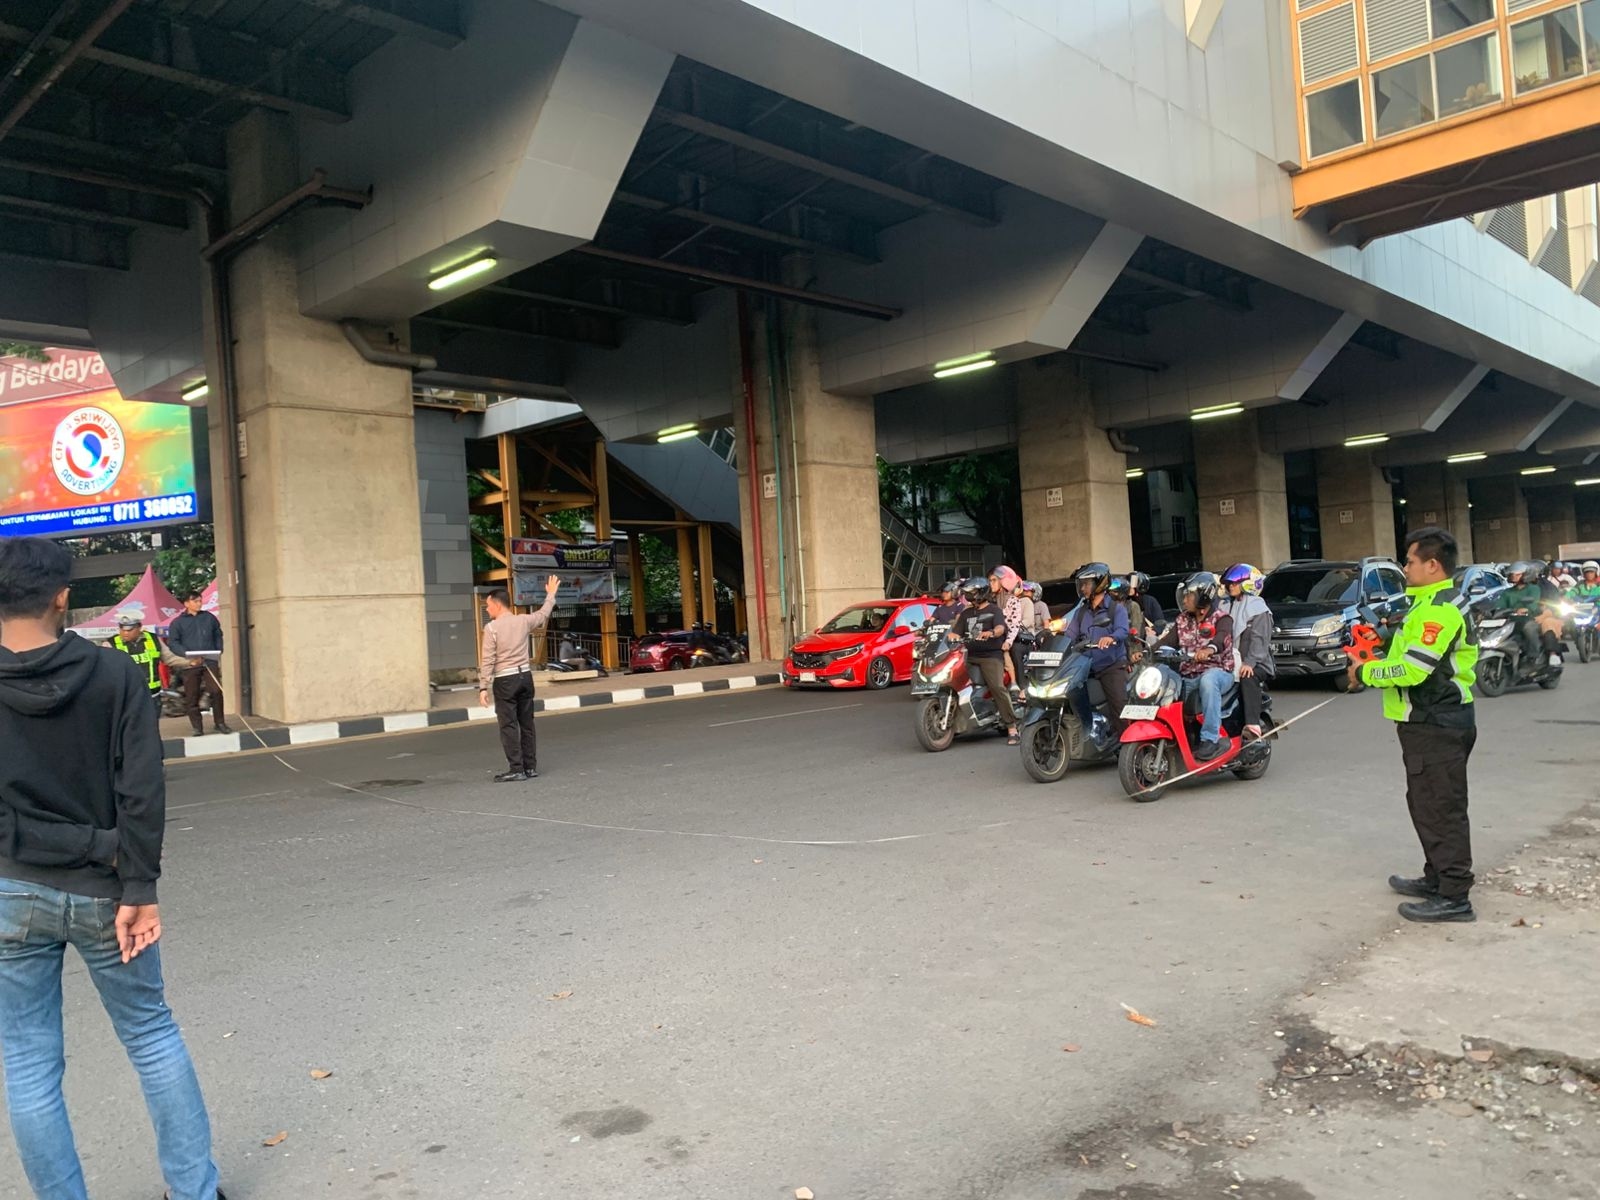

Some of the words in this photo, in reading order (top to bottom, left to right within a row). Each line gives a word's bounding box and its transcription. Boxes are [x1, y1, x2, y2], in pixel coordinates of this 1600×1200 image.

[11, 354, 105, 389] Berdaya
[73, 412, 121, 451] SRIWIJAYA
[61, 460, 117, 490] ADVERTISING
[0, 516, 25, 526] UNTUK
[26, 511, 70, 522] PEMAKAIAN
[71, 507, 98, 517] LOKASI
[100, 505, 111, 513] INI
[73, 515, 107, 525] HUBUNGI
